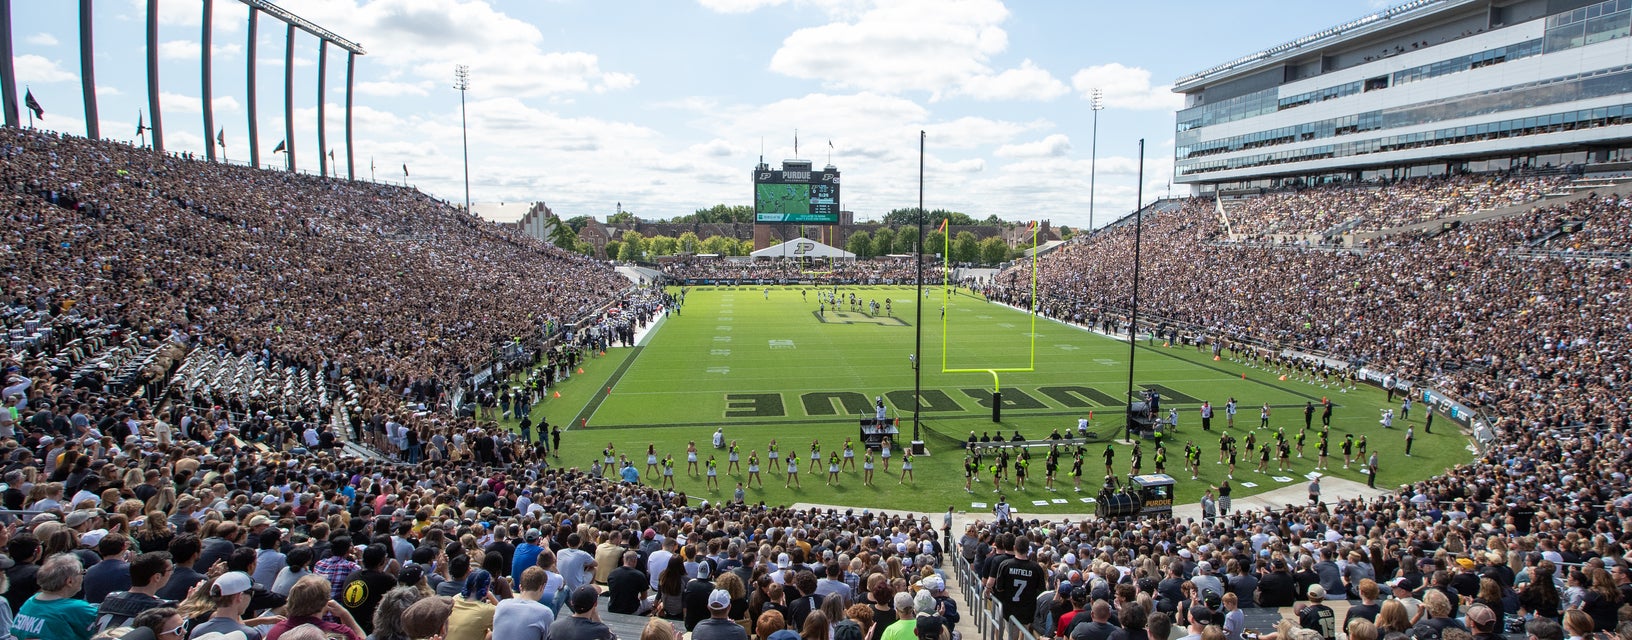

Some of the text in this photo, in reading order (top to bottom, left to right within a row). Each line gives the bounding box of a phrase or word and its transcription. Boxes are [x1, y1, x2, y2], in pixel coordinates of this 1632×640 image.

[782, 171, 811, 180] PURDUE
[725, 386, 1207, 418] PURDUE
[1145, 498, 1172, 507] PURDUE
[1009, 567, 1033, 577] MAYFIELD
[1012, 579, 1028, 602] 7
[12, 612, 45, 635] CSONKA
